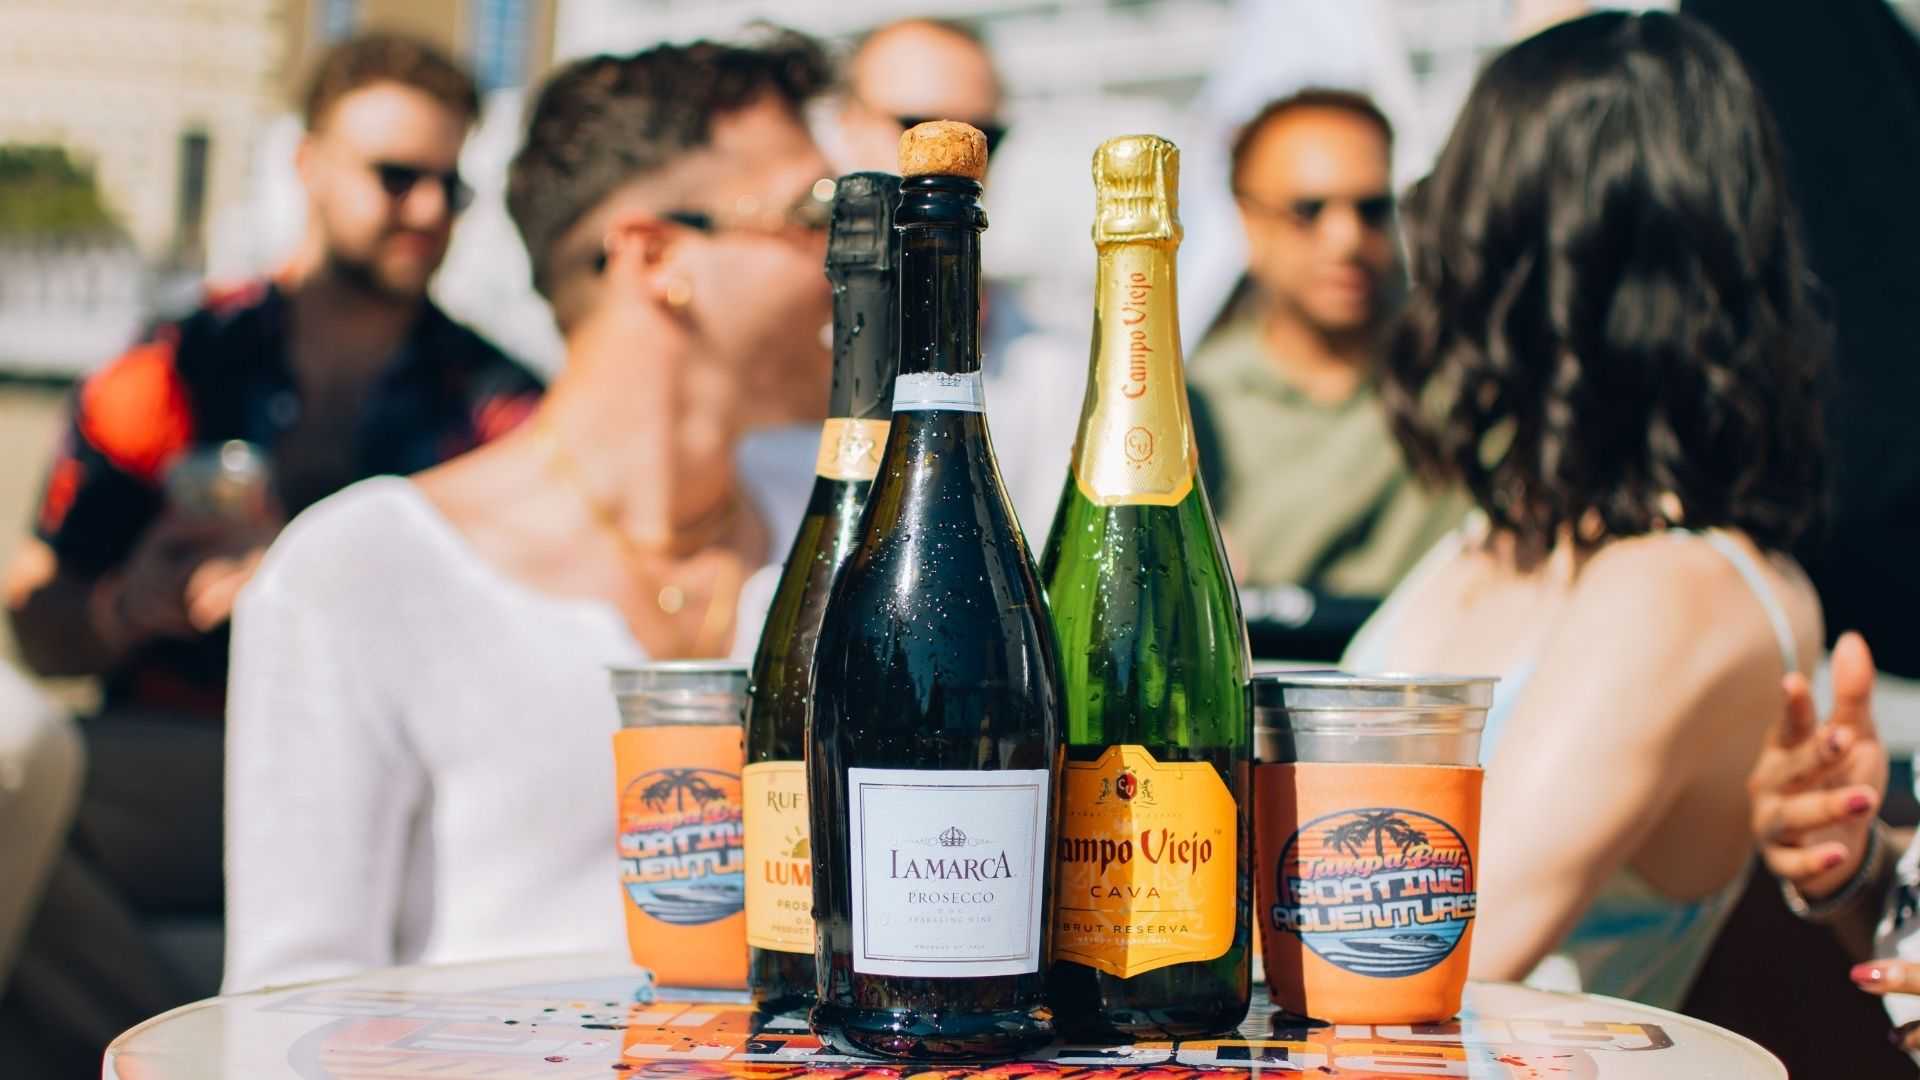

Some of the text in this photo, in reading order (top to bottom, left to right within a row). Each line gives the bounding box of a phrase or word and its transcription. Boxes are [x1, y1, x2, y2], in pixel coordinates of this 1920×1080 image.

[1122, 271, 1154, 399] Campo Viejo
[1140, 828, 1212, 875] Viejo
[908, 891, 994, 904] PROSECCO
[1090, 886, 1160, 899] CAVA
[1290, 868, 1464, 907] BOATING
[1063, 923, 1189, 934] BRUT RESERVA
